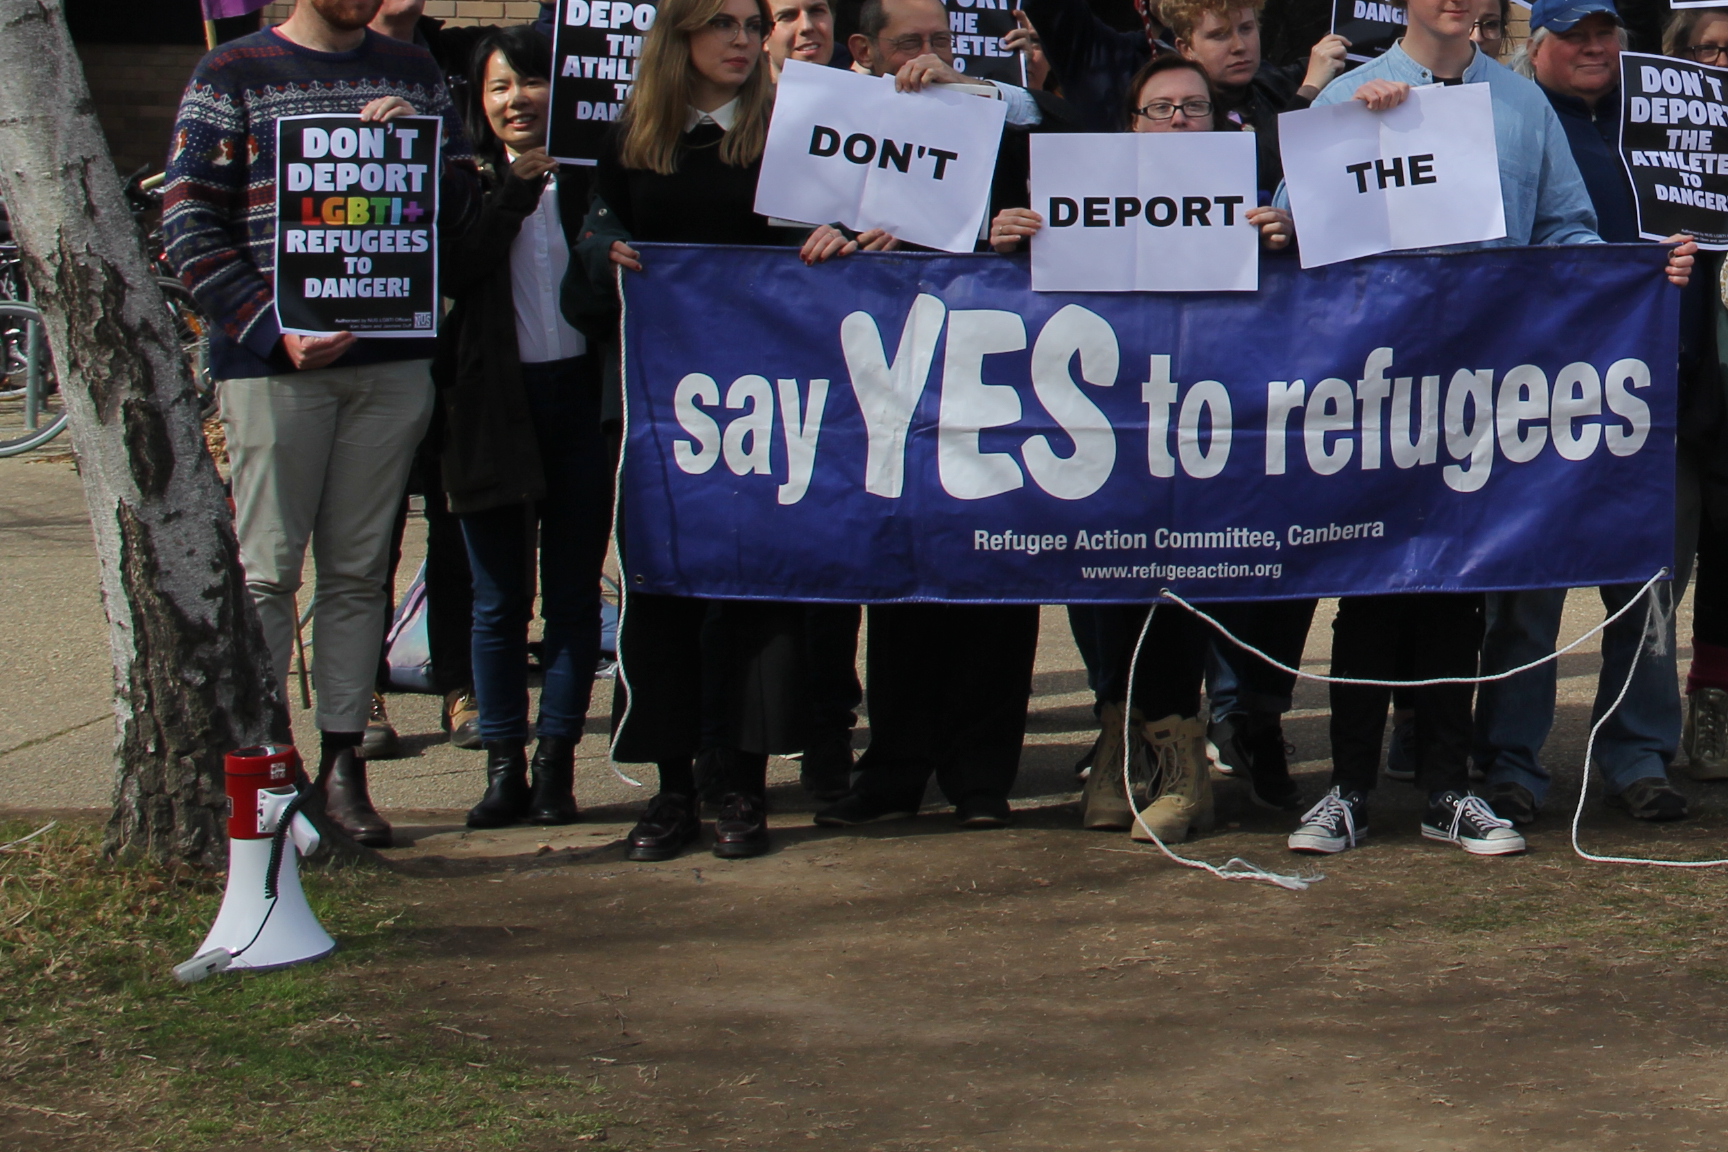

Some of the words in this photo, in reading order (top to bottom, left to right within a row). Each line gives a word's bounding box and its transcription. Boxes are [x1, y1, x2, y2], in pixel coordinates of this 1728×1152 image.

[566, 0, 657, 31] DEPO
[949, 11, 978, 33] HE
[1353, 0, 1408, 26] DANG
[606, 34, 647, 57] TH
[562, 55, 637, 80] ATHL
[1640, 65, 1723, 102] DON'T
[303, 123, 419, 159] DON'T
[808, 124, 957, 181] DON'T
[1666, 129, 1713, 151] THE
[287, 163, 428, 192] DEPORT
[1347, 153, 1437, 195] THE
[1679, 172, 1702, 187] TO
[301, 197, 424, 225] LGBTI+
[1049, 195, 1243, 228] DEPORT
[286, 229, 429, 253] REFUGEES
[344, 256, 372, 275] TO
[305, 277, 410, 298] DANGER!
[673, 372, 829, 505] say
[840, 293, 1120, 501] YES
[1142, 354, 1233, 478] to
[1265, 347, 1651, 493] refugees
[974, 529, 1067, 555] Refugee
[1074, 530, 1147, 551] Action
[1155, 527, 1281, 552] Committee,
[1287, 521, 1384, 546] Canberra
[1082, 562, 1282, 580] www.refugeeaction.org
